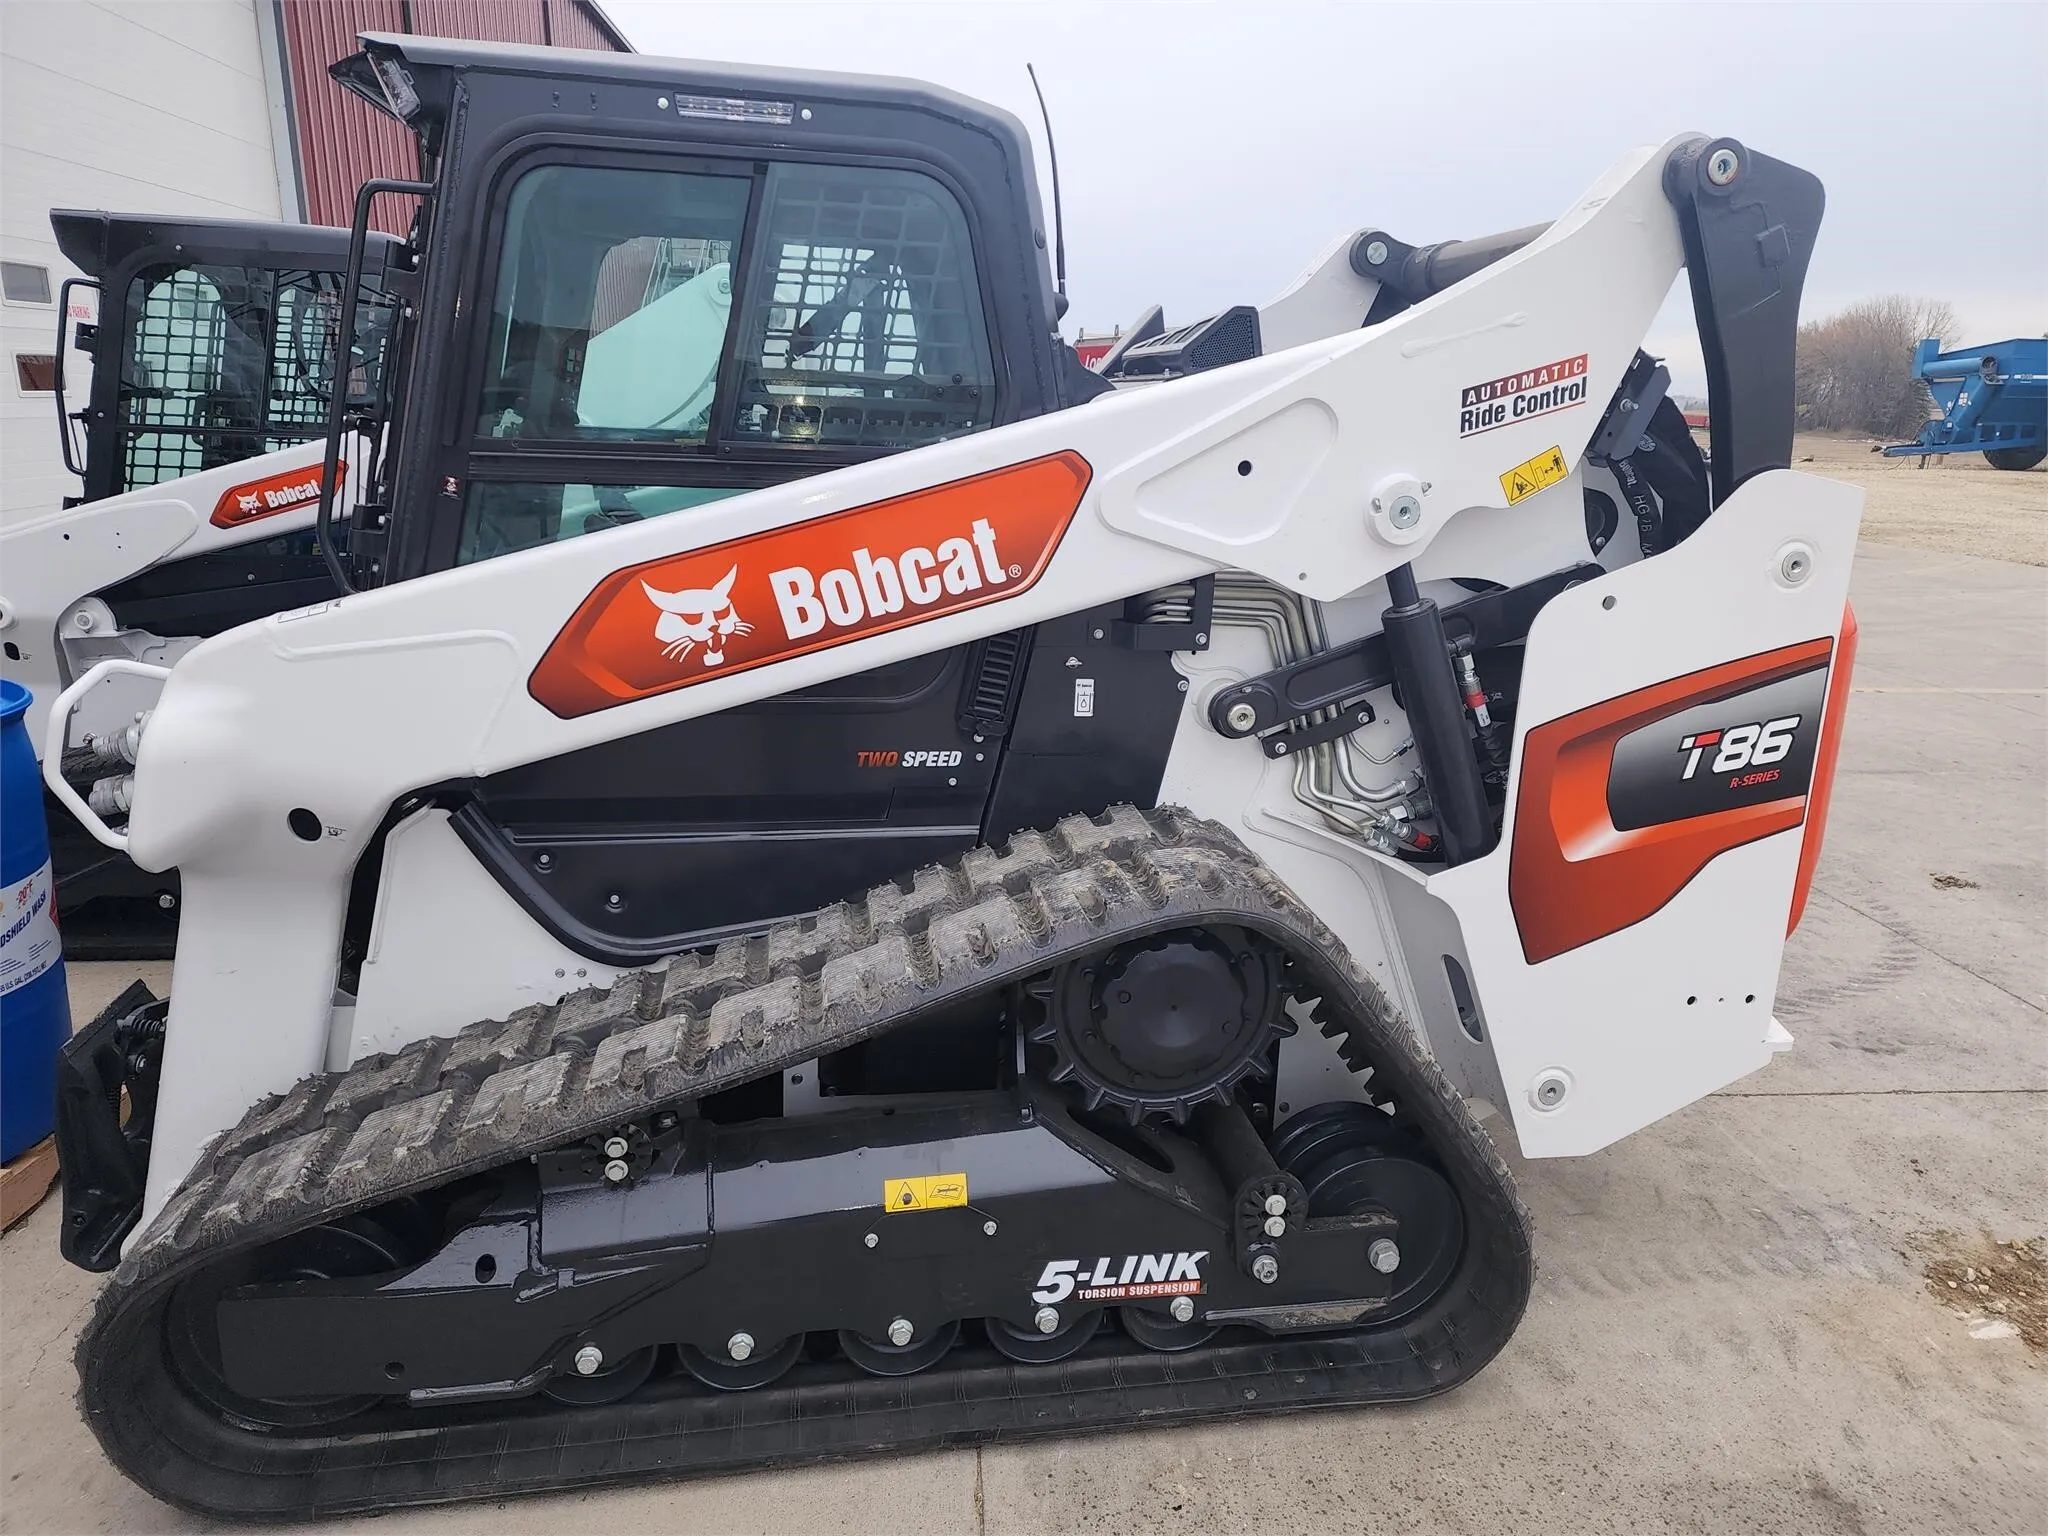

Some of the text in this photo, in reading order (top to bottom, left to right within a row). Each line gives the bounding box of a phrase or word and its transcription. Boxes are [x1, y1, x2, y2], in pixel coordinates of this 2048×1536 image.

[1460, 375, 1588, 433] Ride Control
[1466, 358, 1584, 406] AUTOMATIC
[264, 479, 322, 508] Bobcat
[768, 517, 1008, 641] Bobcat
[857, 751, 962, 767] TWO SPEED
[1680, 715, 1801, 780] T86
[1729, 769, 1781, 789] R-SERIES
[1032, 1251, 1210, 1304] 5-LINK
[1078, 1282, 1198, 1300] TORSION SUSPENSION
